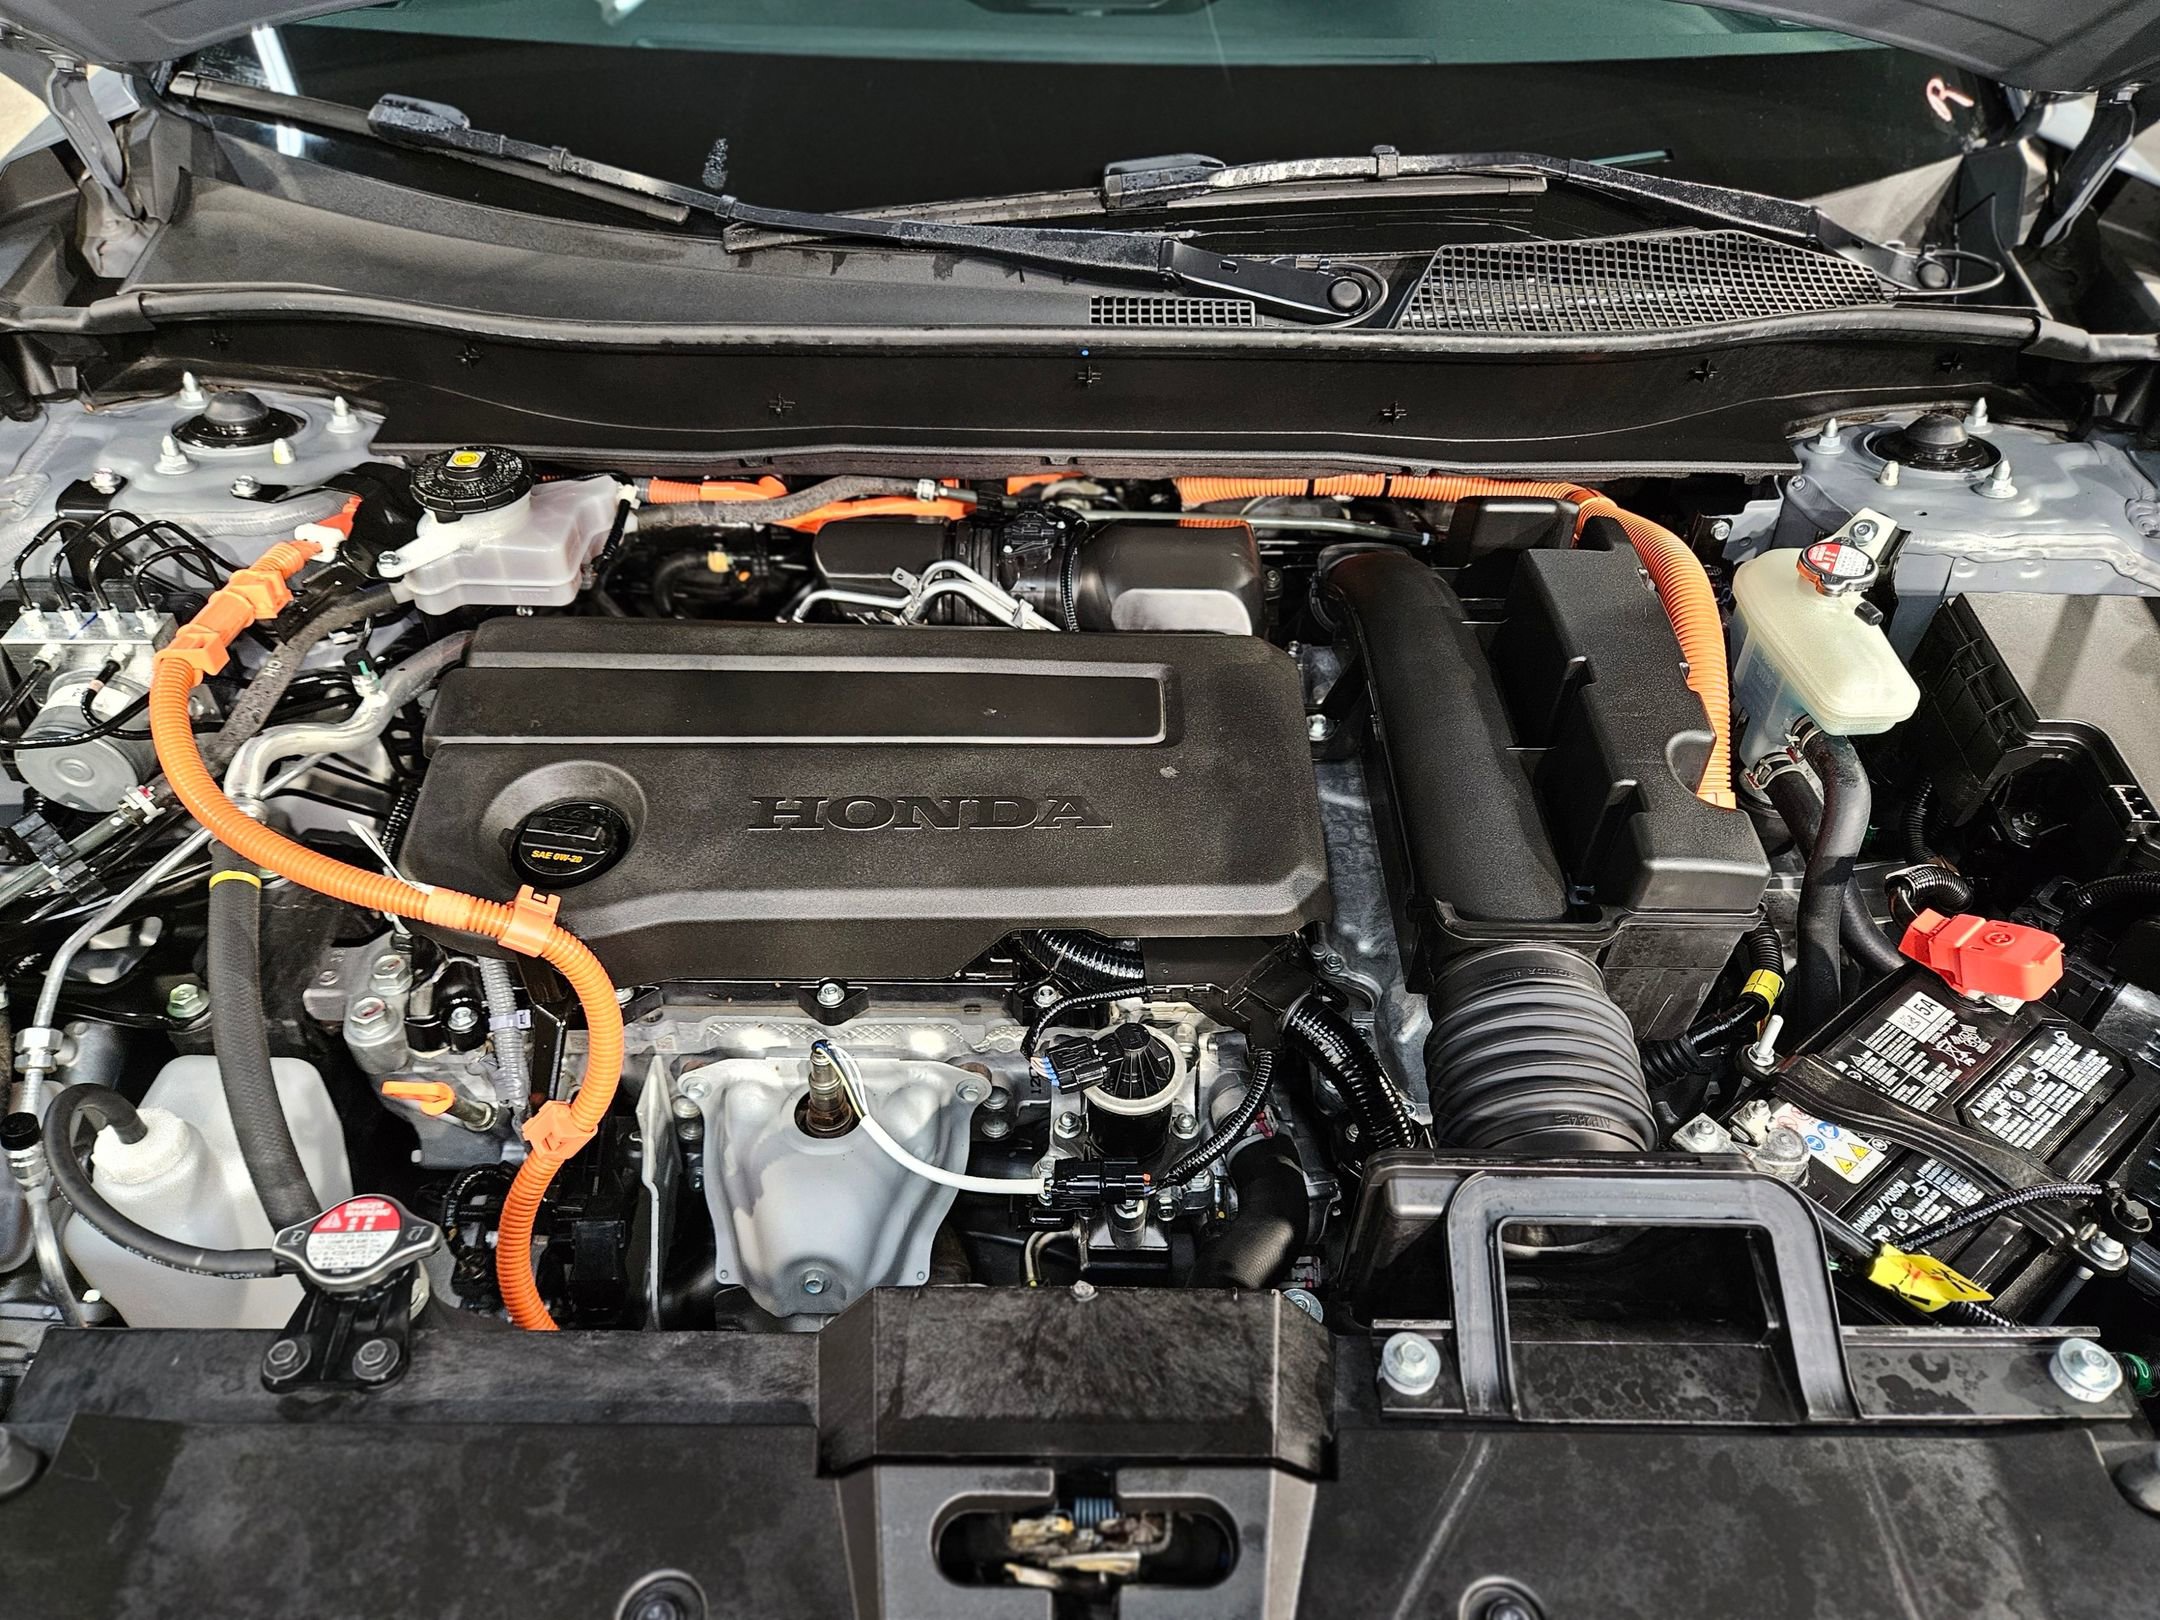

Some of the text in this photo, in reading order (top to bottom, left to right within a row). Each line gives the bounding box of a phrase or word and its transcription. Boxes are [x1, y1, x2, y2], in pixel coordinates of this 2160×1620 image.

[747, 795, 1114, 831] HONDA
[531, 850, 583, 863] SAE 0W-20
[1913, 998, 1939, 1017] 5A
